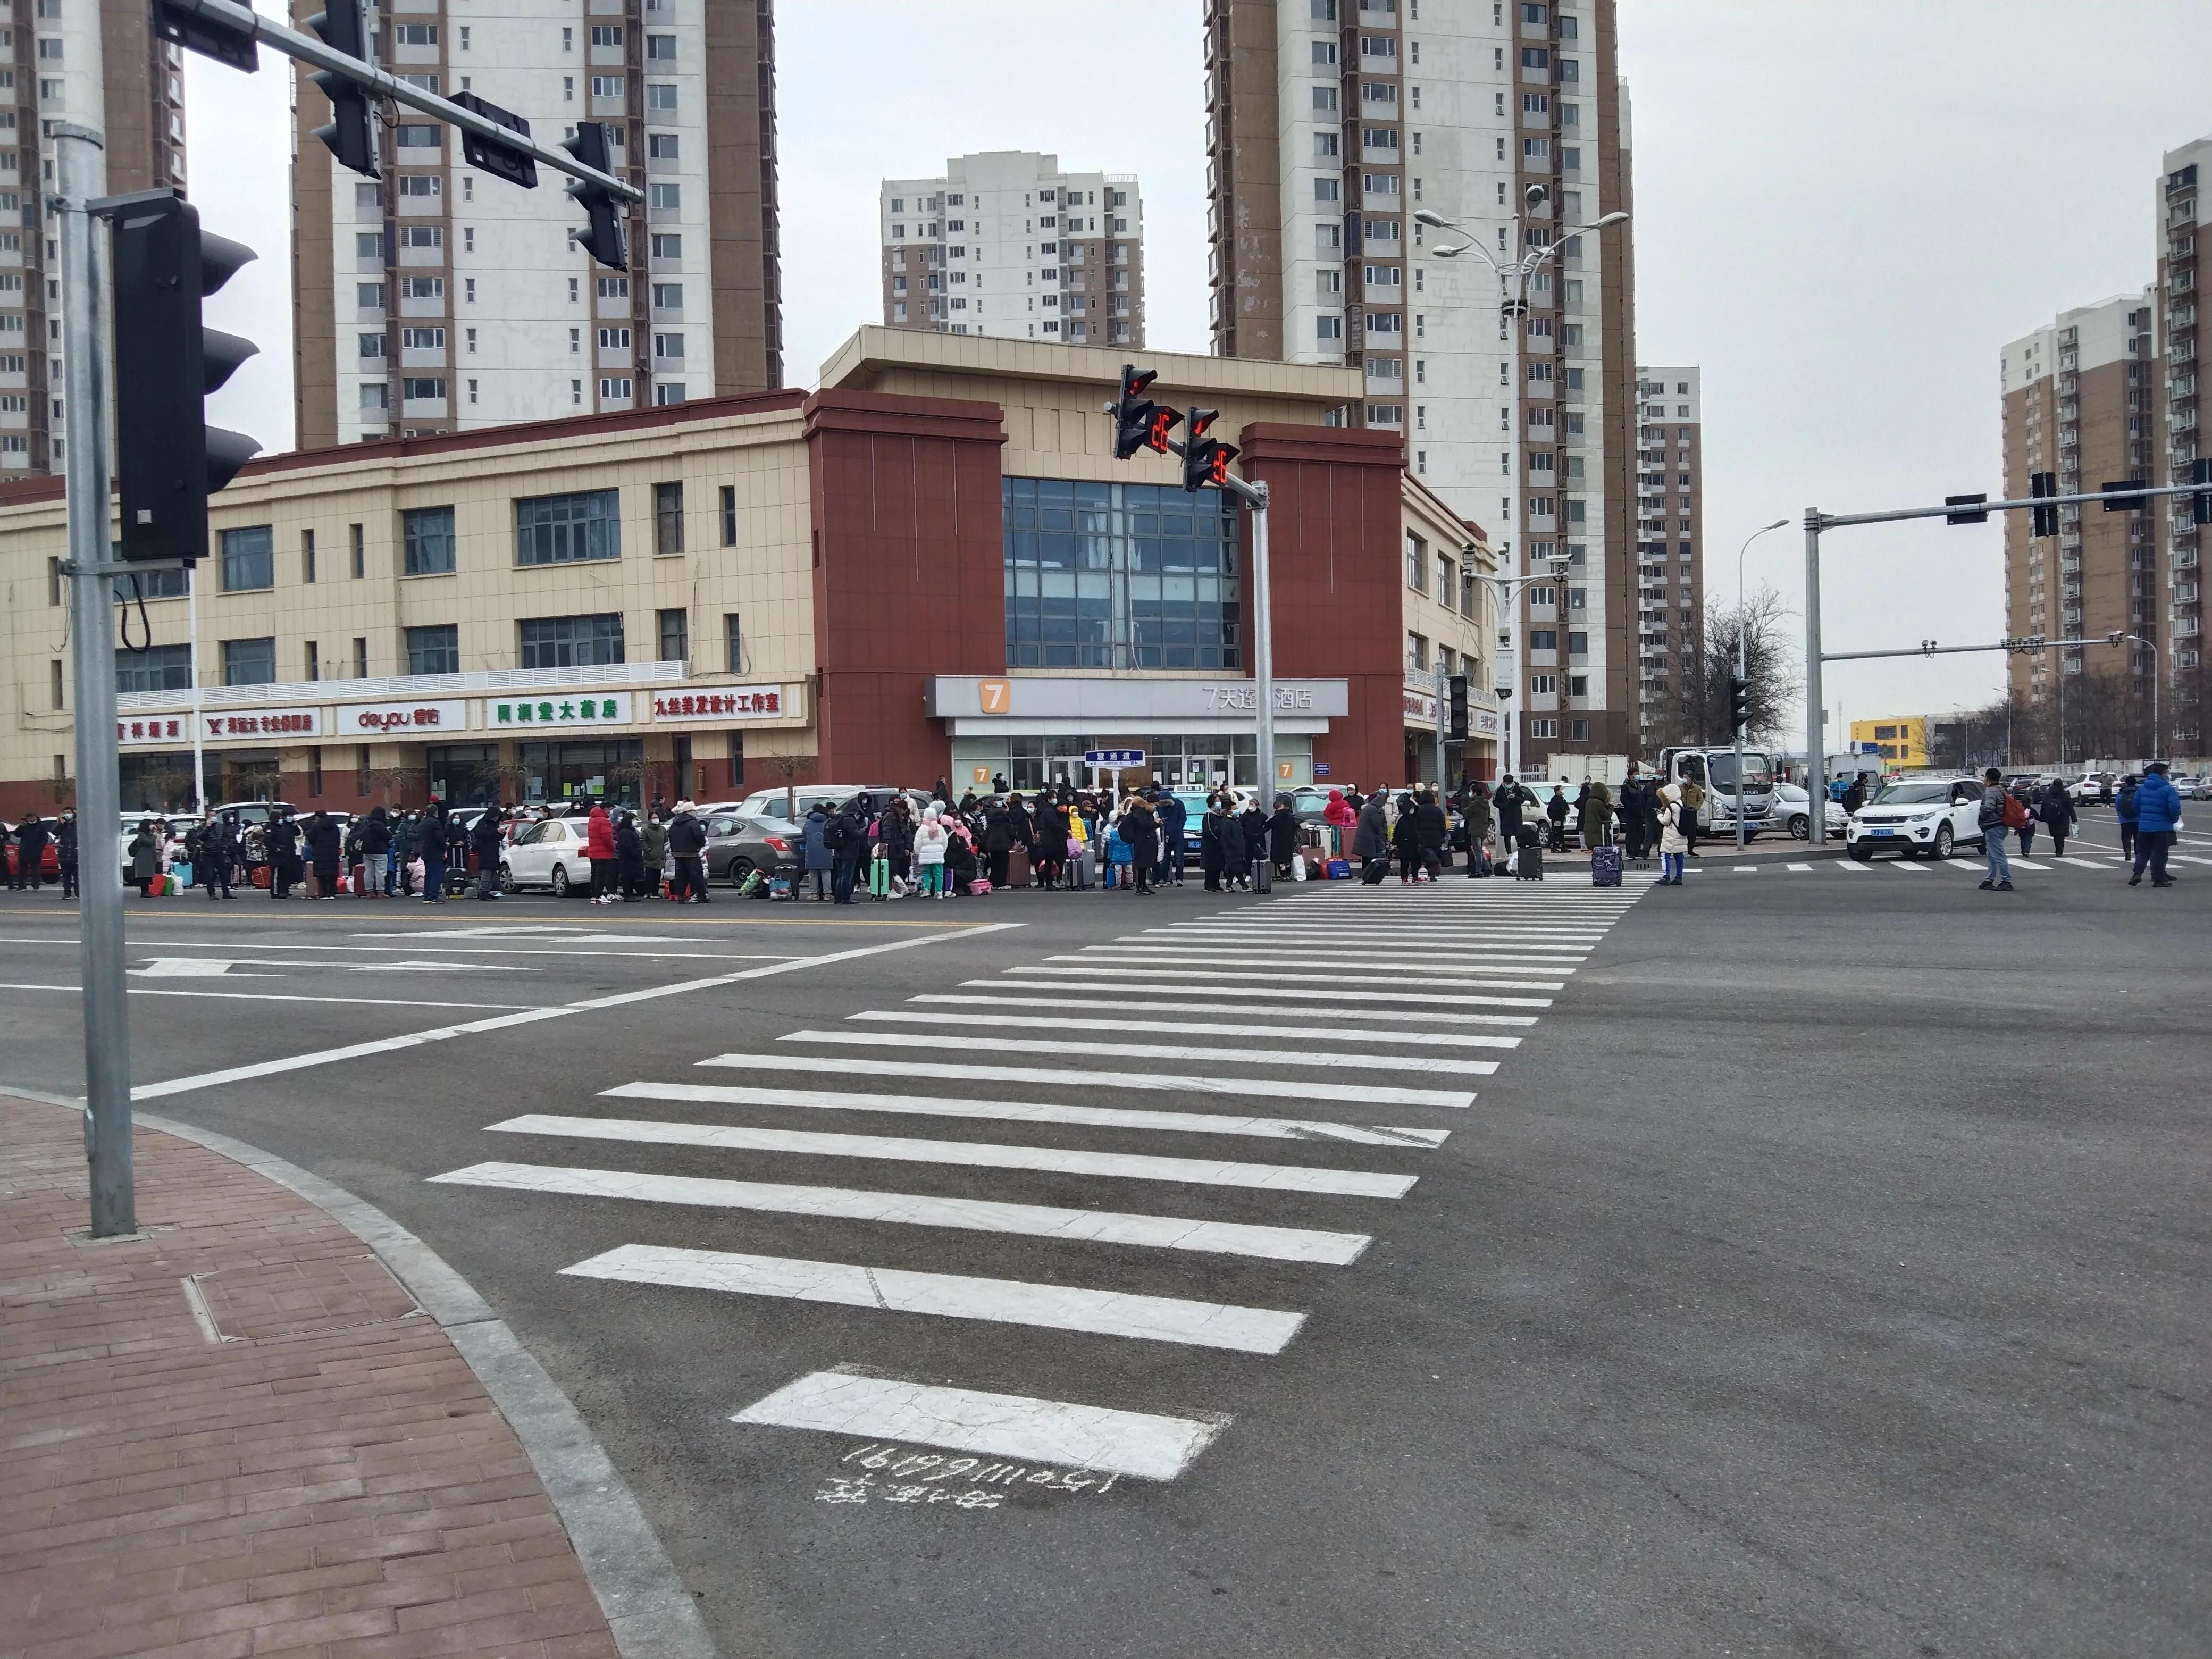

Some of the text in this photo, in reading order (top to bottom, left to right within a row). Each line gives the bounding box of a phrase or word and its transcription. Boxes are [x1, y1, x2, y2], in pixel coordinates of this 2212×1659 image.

[655, 692, 780, 716] 九丝美发设计工作室
[985, 684, 1004, 709] 7
[1203, 686, 1312, 710] 7天连酒店
[977, 769, 987, 782] 7
[1281, 764, 1291, 776] 7
